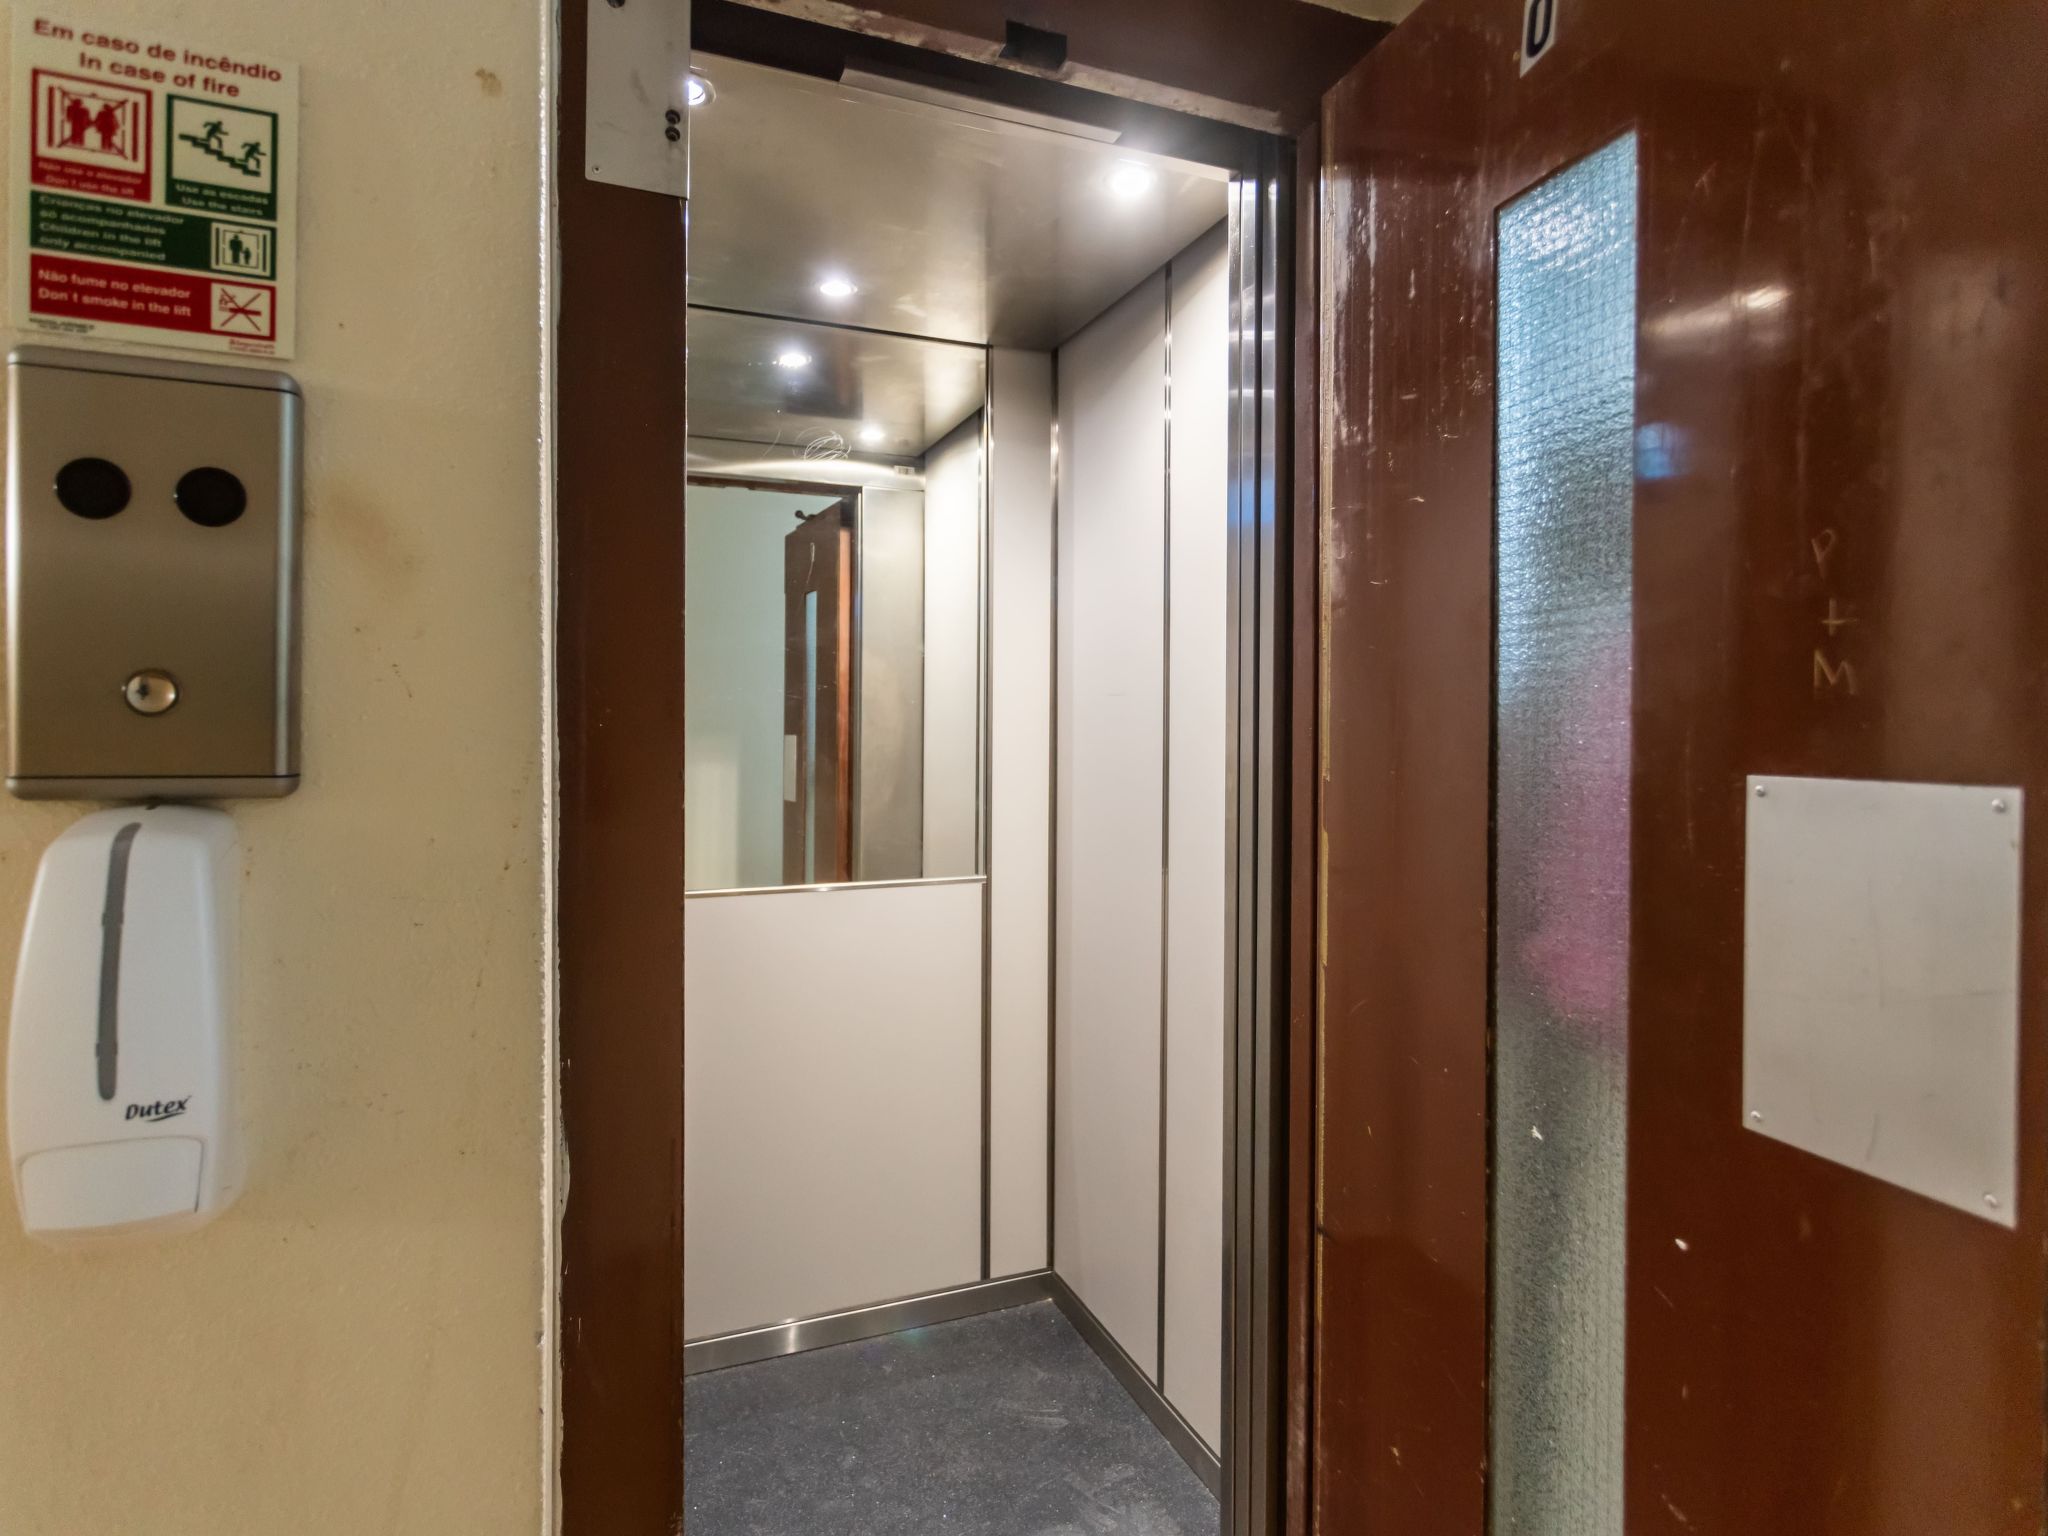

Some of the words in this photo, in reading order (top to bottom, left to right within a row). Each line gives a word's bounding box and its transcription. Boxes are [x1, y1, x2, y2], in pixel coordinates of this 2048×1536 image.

[33, 18, 74, 41] Em
[81, 29, 140, 54] caso
[147, 44, 177, 62] de
[183, 49, 282, 82] incêndio
[79, 52, 102, 70] In
[109, 61, 166, 83] case
[173, 73, 196, 89] of
[202, 77, 240, 97] fire
[61, 213, 166, 235] acompanhadas
[105, 206, 124, 216] no
[127, 209, 184, 225] elevador
[39, 222, 99, 239] Children
[102, 231, 117, 241] in
[119, 233, 142, 244] the
[144, 236, 162, 247] lift
[39, 236, 70, 249] only
[73, 241, 166, 261] accompanied
[38, 268, 68, 283] Não
[71, 273, 107, 289] fume
[110, 280, 129, 291] no
[132, 282, 191, 299] elevador
[82, 294, 129, 310] smoke
[132, 300, 145, 311] in
[148, 302, 170, 314] the
[173, 305, 191, 317] lift
[125, 1095, 192, 1121] Dutex
